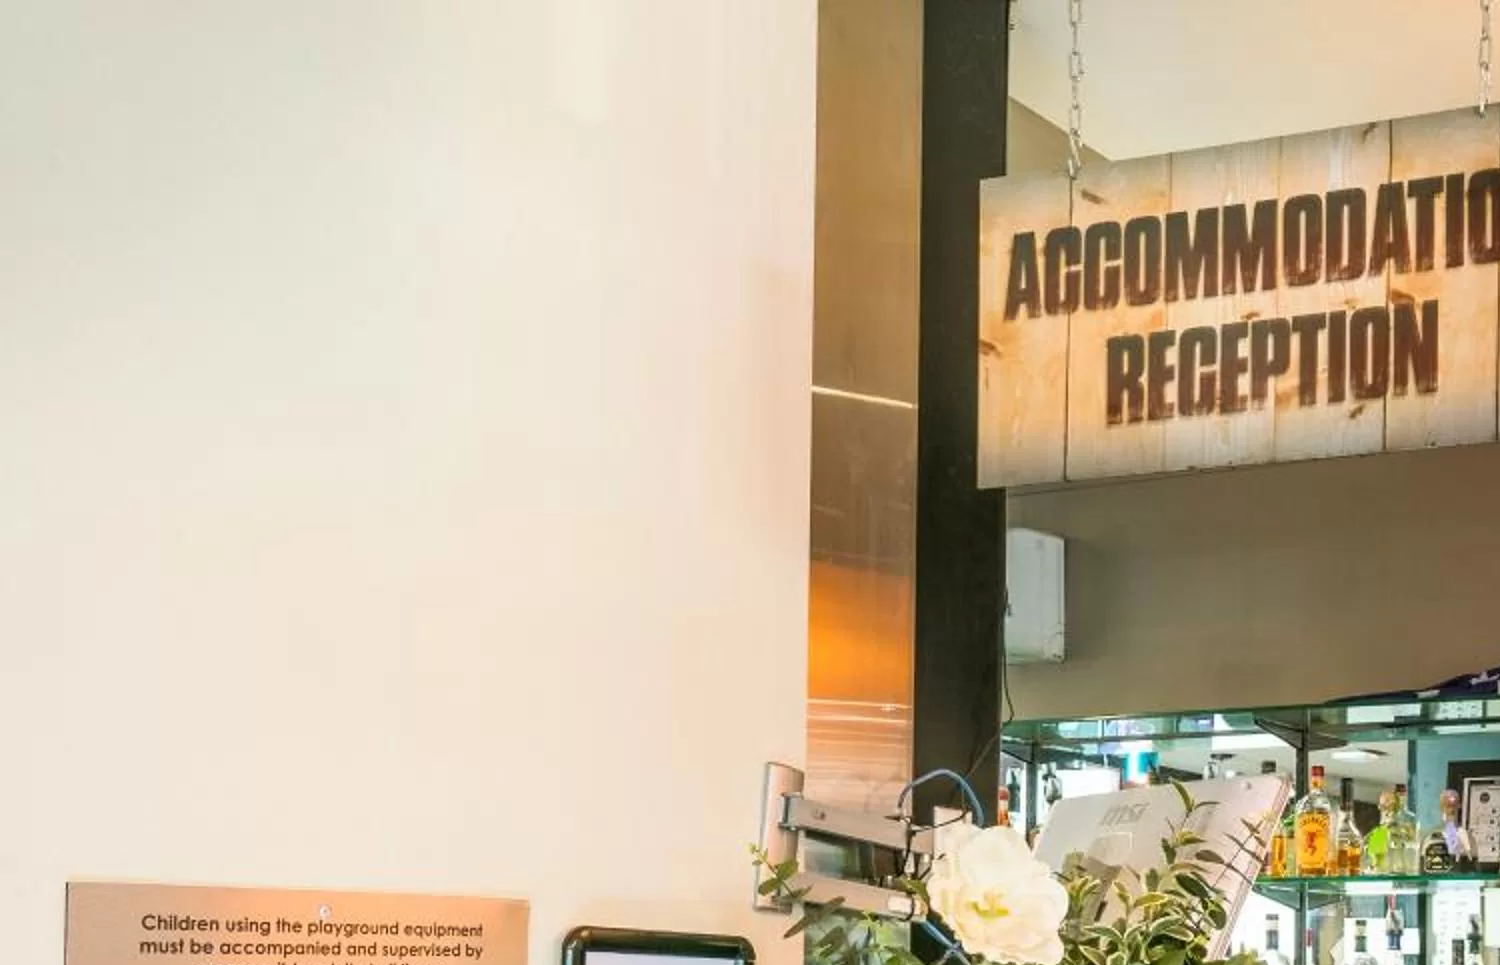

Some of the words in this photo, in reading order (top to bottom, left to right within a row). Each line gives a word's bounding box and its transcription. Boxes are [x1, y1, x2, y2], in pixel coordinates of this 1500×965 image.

[1106, 298, 1440, 428] RECEPTION
[141, 915, 221, 932] Children
[225, 917, 271, 936] using
[275, 918, 303, 933] the
[307, 920, 399, 938] playground
[404, 922, 483, 939] equipment
[139, 939, 185, 954] must
[189, 940, 214, 955] be
[220, 940, 342, 956] accompanied
[346, 942, 377, 956] and
[382, 943, 461, 959] supervised
[465, 944, 483, 960] by
